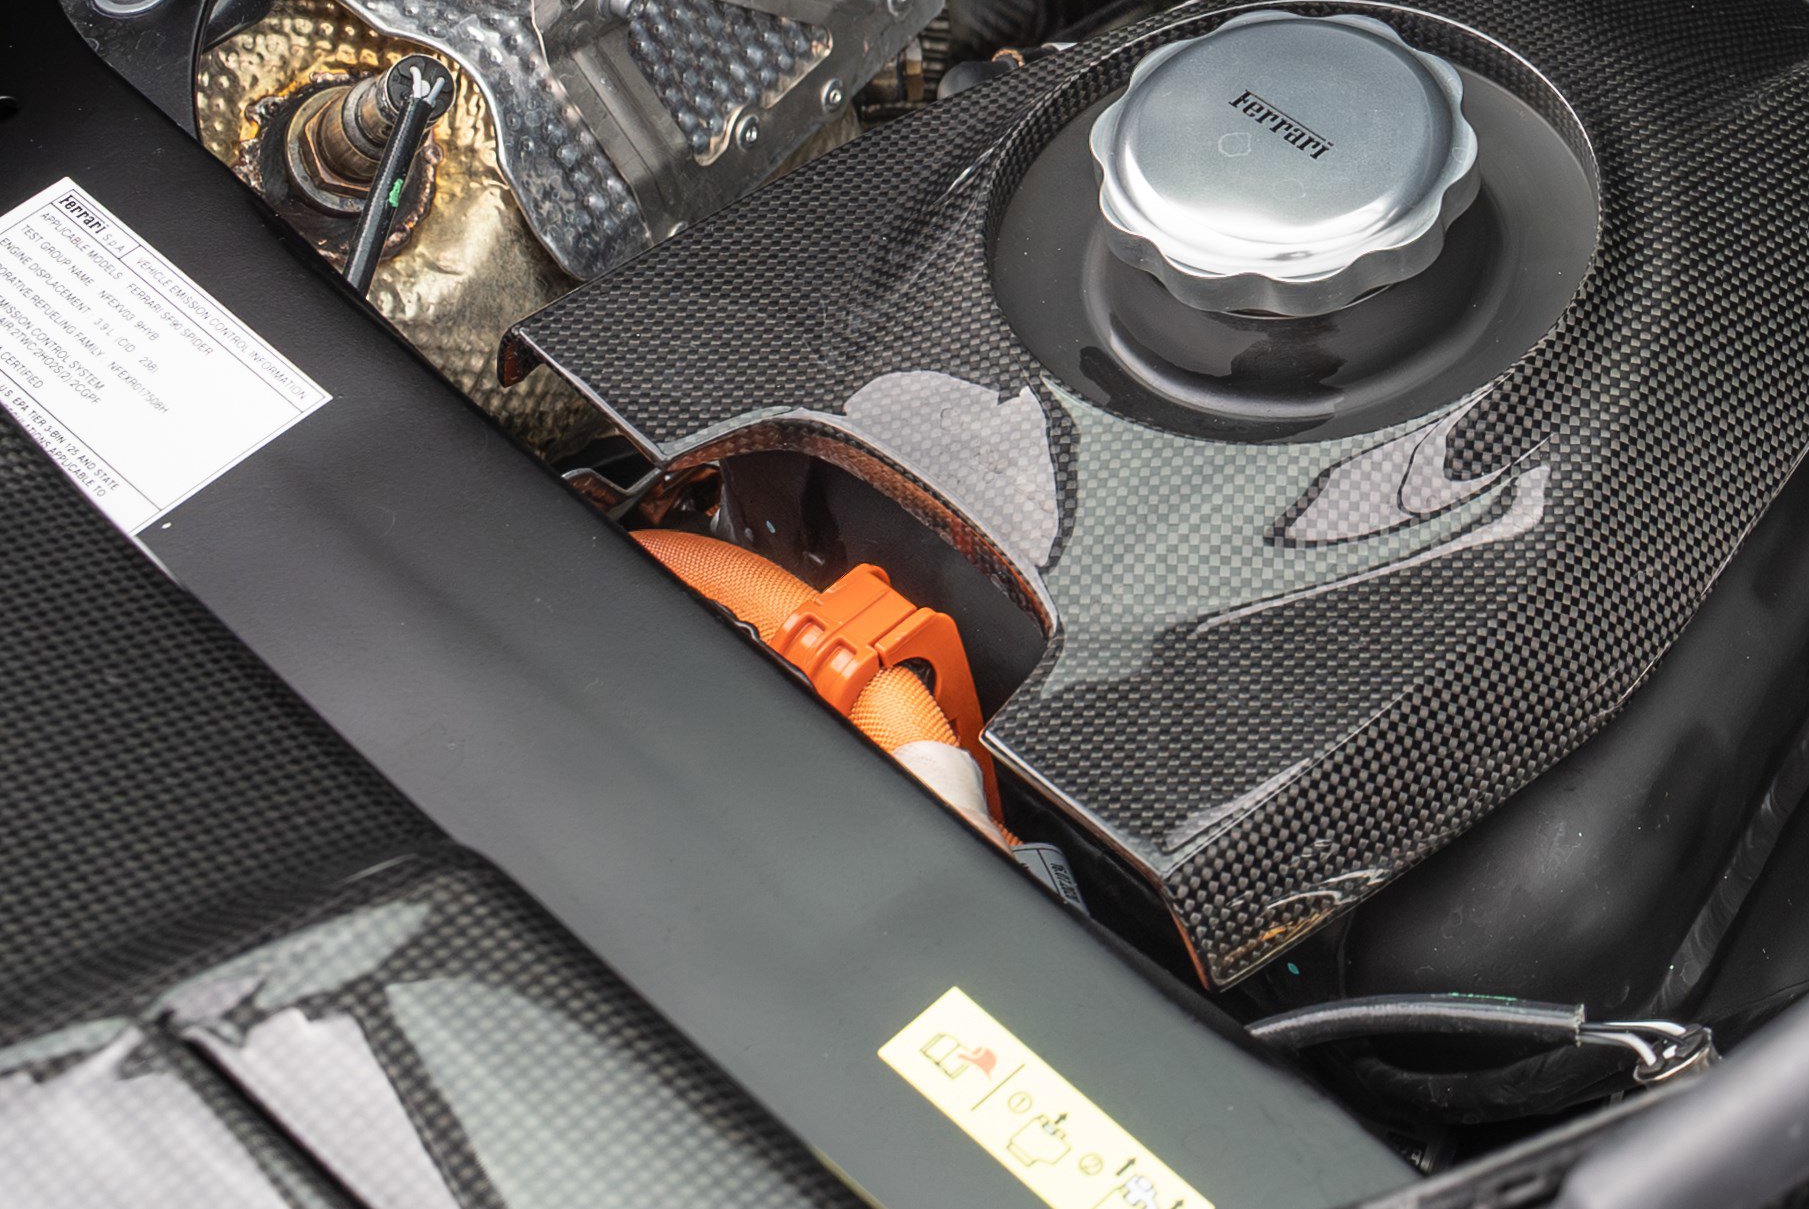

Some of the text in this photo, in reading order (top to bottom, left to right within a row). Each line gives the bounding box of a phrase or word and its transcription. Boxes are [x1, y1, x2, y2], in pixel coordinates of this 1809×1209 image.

[1228, 89, 1334, 160] Ferrari
[0, 237, 33, 265] ENGINE
[28, 262, 92, 314] DISPLACEMENT
[20, 223, 44, 244] TEST
[40, 241, 72, 266] GROUP
[68, 265, 95, 287] NAME
[41, 212, 91, 254] APPLICABLE
[87, 249, 123, 280] MODELS
[127, 283, 164, 313] FERRARI
[180, 328, 214, 356] SPIDER
[31, 294, 77, 335] REFUELING
[74, 331, 104, 358] FAMILY
[59, 194, 109, 234] Ferrari
[136, 257, 172, 289] VEHICLE
[169, 285, 211, 321] EMISSION
[208, 317, 250, 354] CONTROL
[249, 351, 308, 400] INFORMATION
[0, 351, 44, 389] CERTIFIED
[31, 328, 71, 363] CONTROL
[69, 360, 105, 390] SYSTEM
[12, 396, 29, 412] EPA
[28, 410, 47, 428] TIER
[65, 442, 80, 457] 125
[77, 454, 96, 471] AND
[93, 467, 120, 492] STATE
[49, 447, 107, 497] APPLICABLE TO
